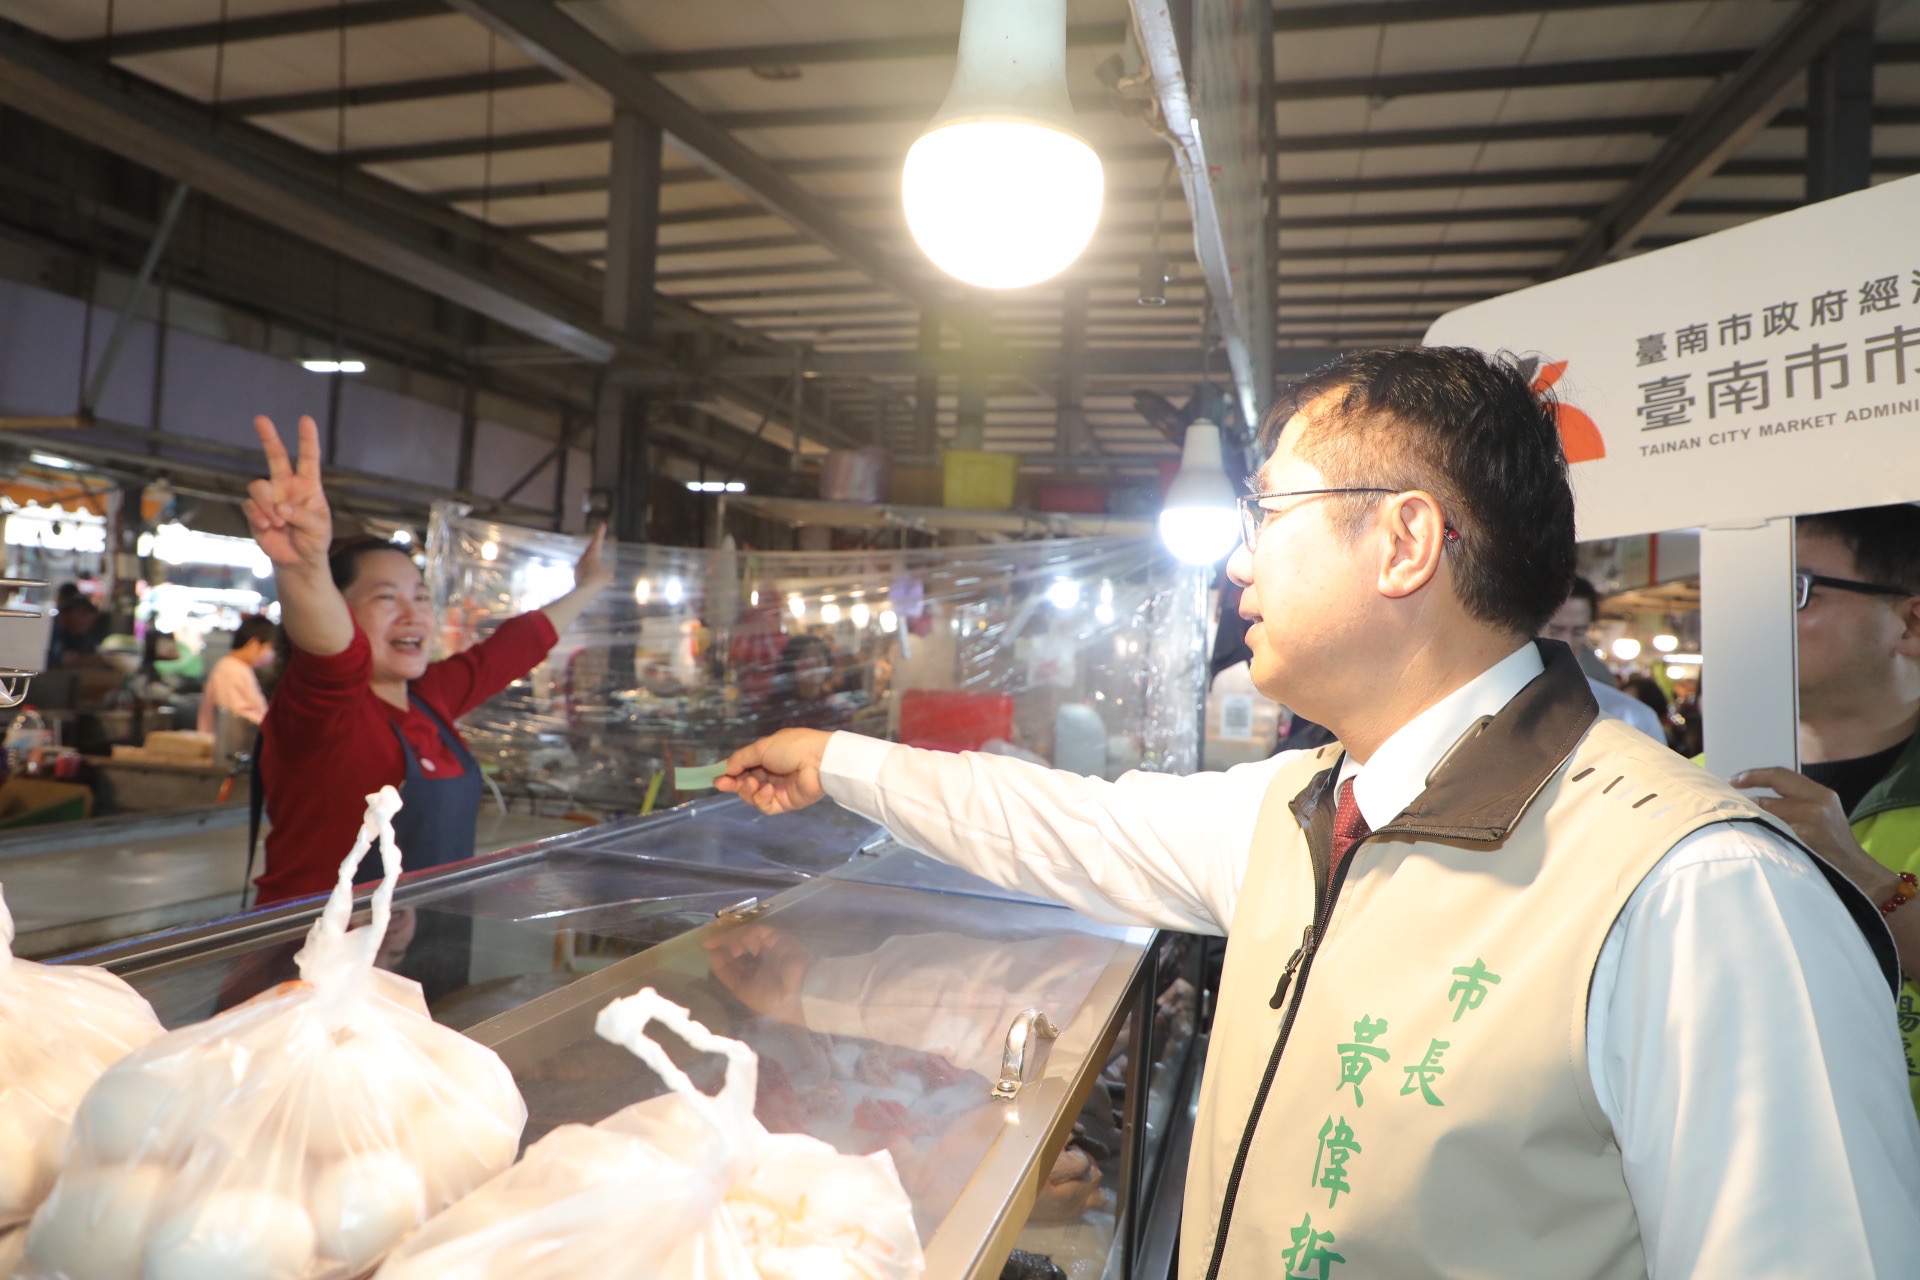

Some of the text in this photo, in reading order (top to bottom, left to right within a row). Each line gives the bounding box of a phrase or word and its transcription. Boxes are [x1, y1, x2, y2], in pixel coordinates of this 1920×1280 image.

[1635, 268, 1920, 367] 臺南市政府經
[1639, 398, 1920, 458] TAINAN CITY MARKET ADMINI
[1399, 957, 1502, 1107] 市長
